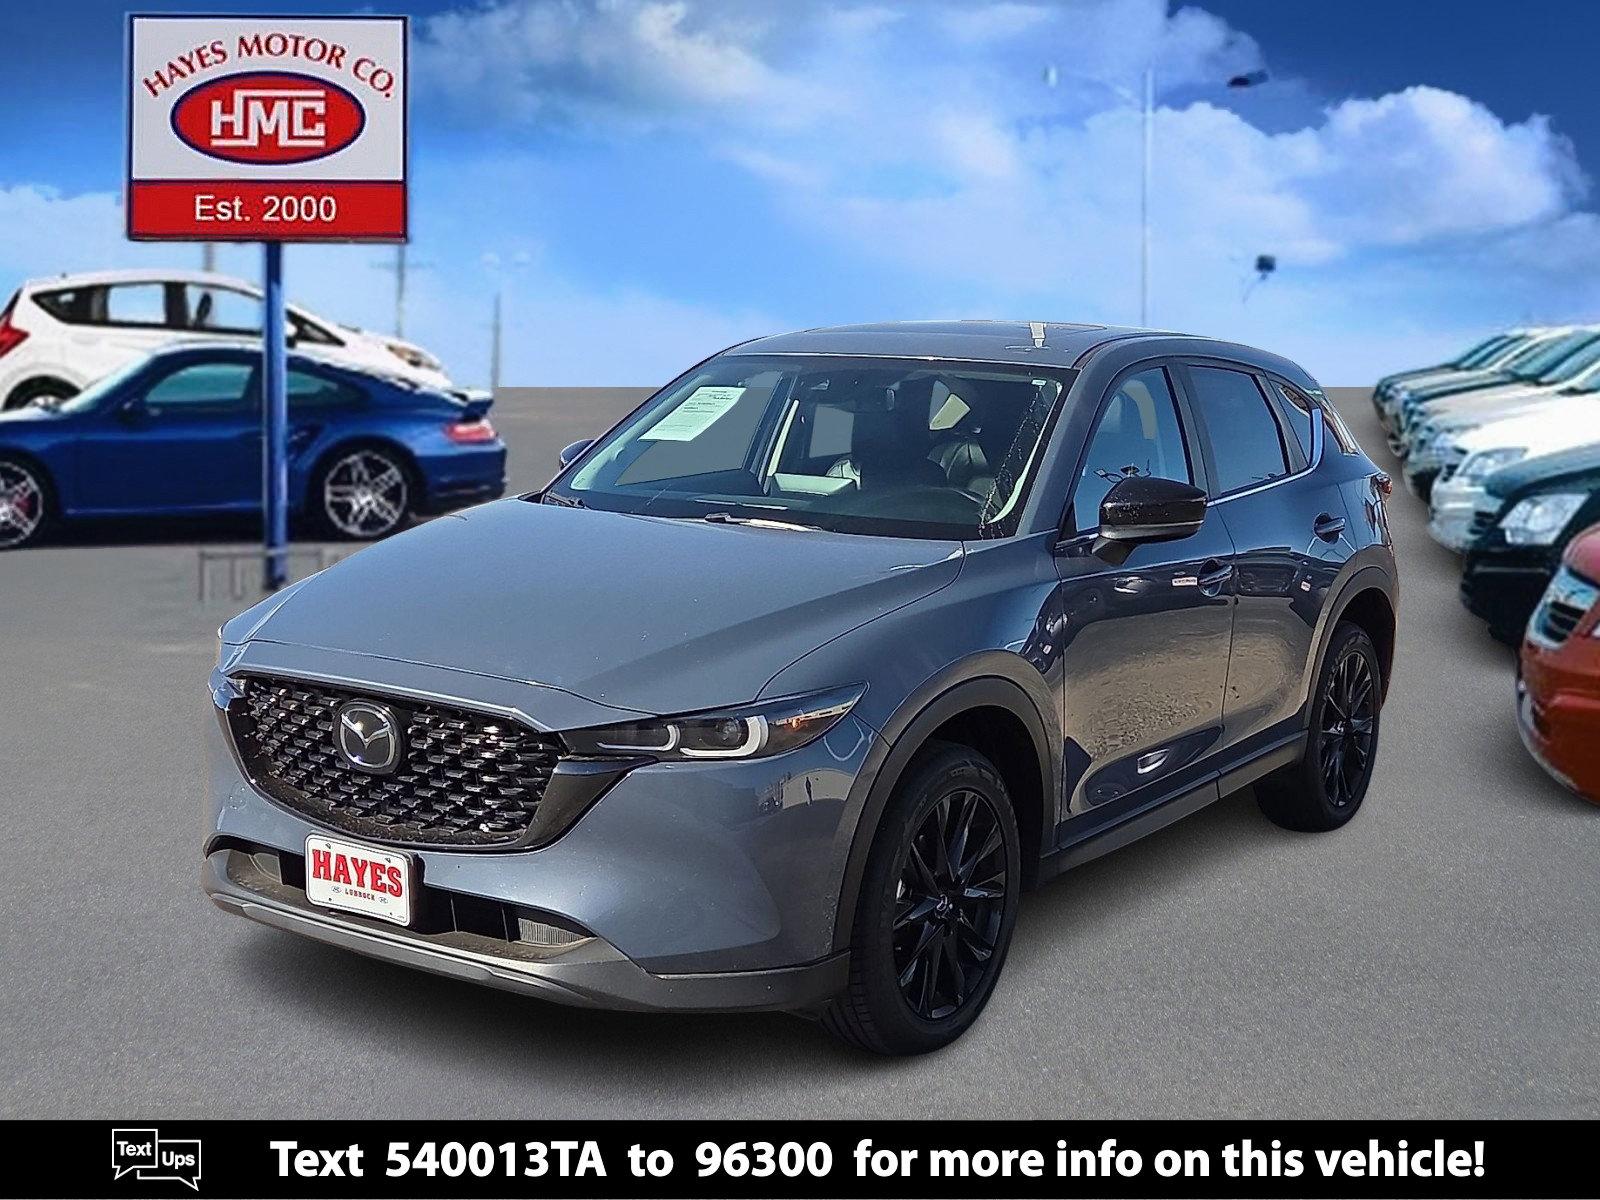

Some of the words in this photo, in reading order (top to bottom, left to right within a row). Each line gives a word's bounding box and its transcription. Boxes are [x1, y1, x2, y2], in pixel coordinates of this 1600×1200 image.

[142, 39, 228, 98] HAYES
[237, 32, 347, 70] MOTOR
[352, 57, 394, 99] CO.
[210, 89, 327, 148] HMC
[194, 194, 251, 222] Est.
[262, 194, 337, 222] 2000
[312, 848, 403, 898] HAYES
[345, 888, 375, 901] LUBBOCK
